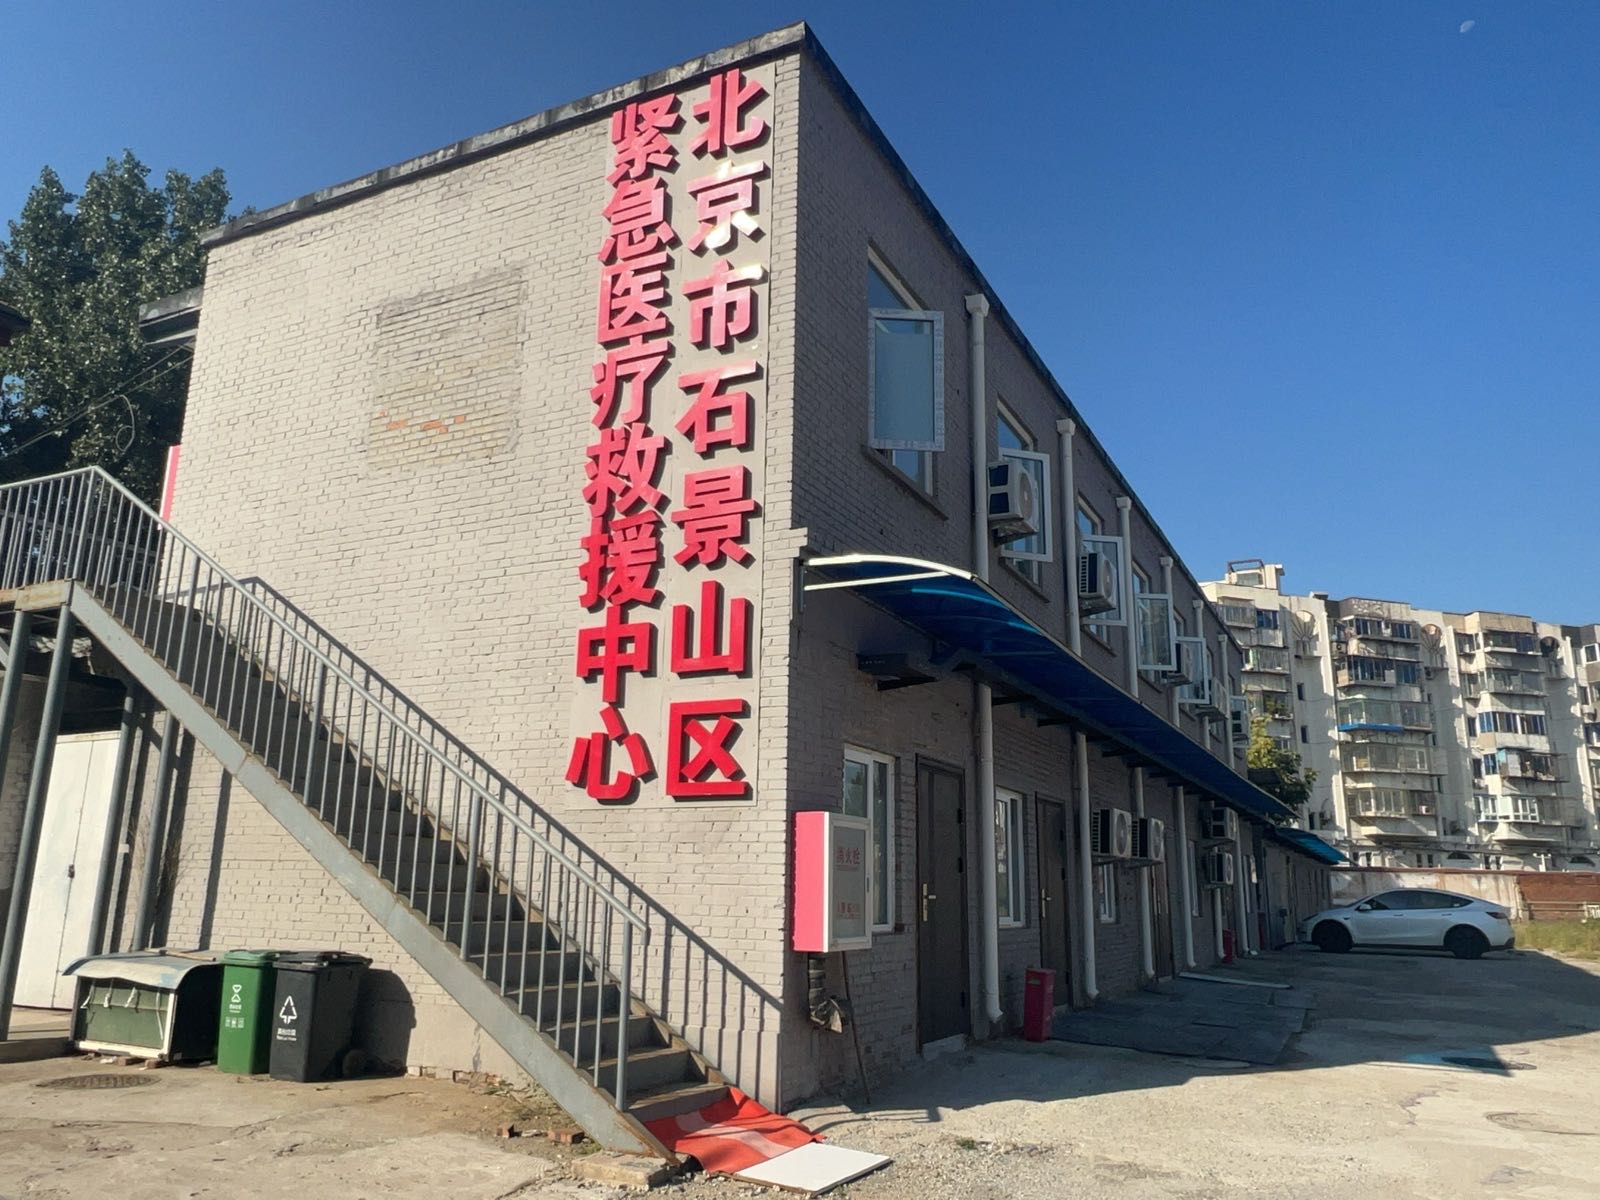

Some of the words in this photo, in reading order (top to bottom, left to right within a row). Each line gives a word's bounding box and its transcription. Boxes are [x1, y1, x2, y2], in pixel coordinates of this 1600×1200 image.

[565, 93, 680, 800] 紧急医疗救援中心
[666, 68, 768, 798] 北京市石景山区
